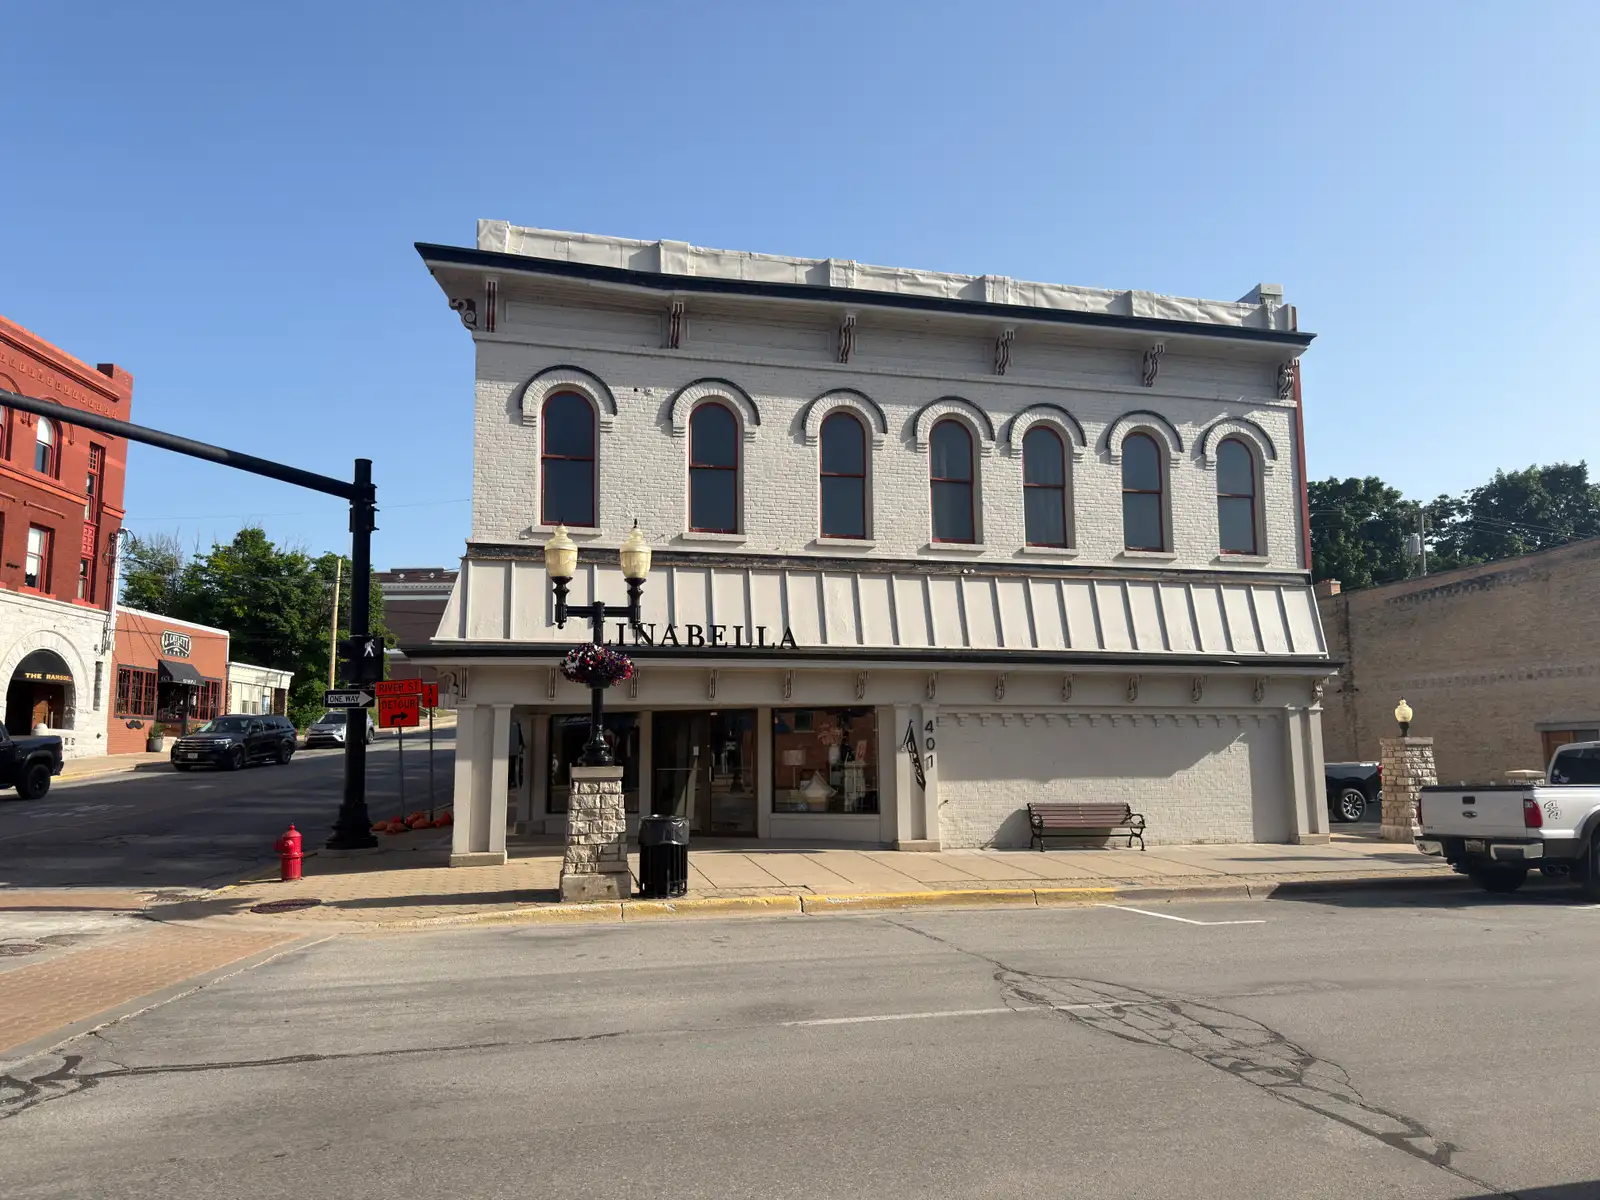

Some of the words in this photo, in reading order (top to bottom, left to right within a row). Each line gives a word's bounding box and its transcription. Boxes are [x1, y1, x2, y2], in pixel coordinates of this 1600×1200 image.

[379, 684, 404, 693] RIVER
[408, 683, 418, 691] ST
[329, 695, 343, 703] ONE
[345, 695, 359, 703] WAY
[382, 699, 414, 710] DETOUR
